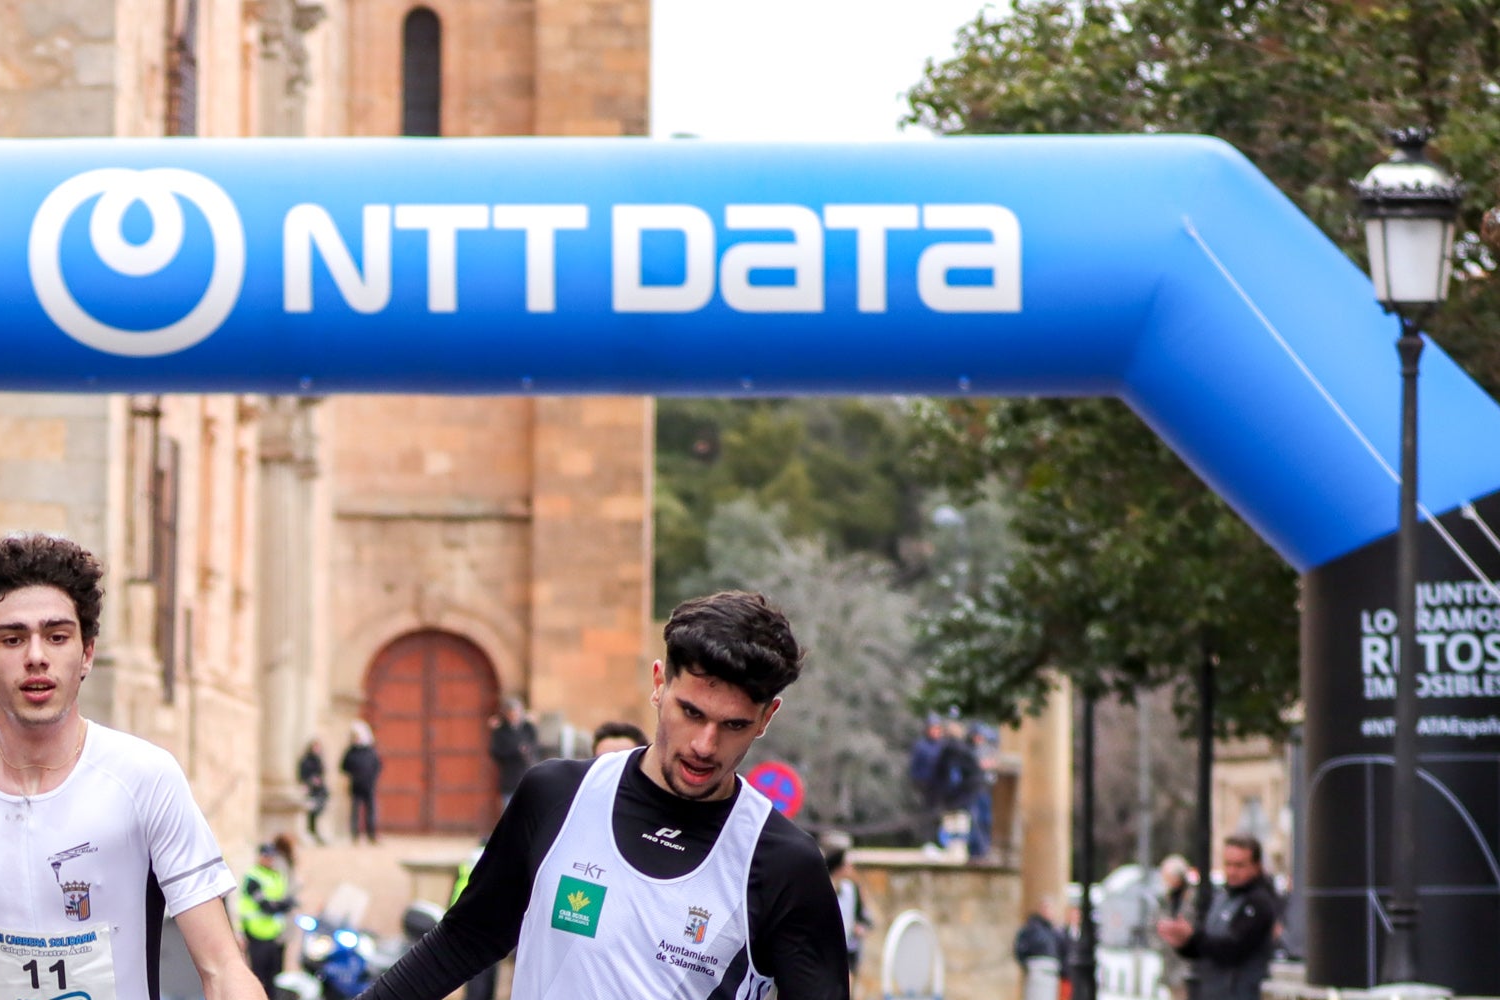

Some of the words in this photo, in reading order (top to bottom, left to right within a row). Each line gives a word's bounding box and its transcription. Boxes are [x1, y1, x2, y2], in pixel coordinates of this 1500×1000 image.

[283, 203, 589, 314] NTT
[641, 833, 659, 843] PRO
[659, 839, 686, 852] TOUCH
[5, 934, 47, 948] CARRERA
[48, 931, 97, 947] SOLIDARIA
[659, 938, 719, 966] Ayuntamiento
[22, 959, 66, 990] 11
[656, 951, 667, 963] de
[668, 954, 716, 977] Salamanca
